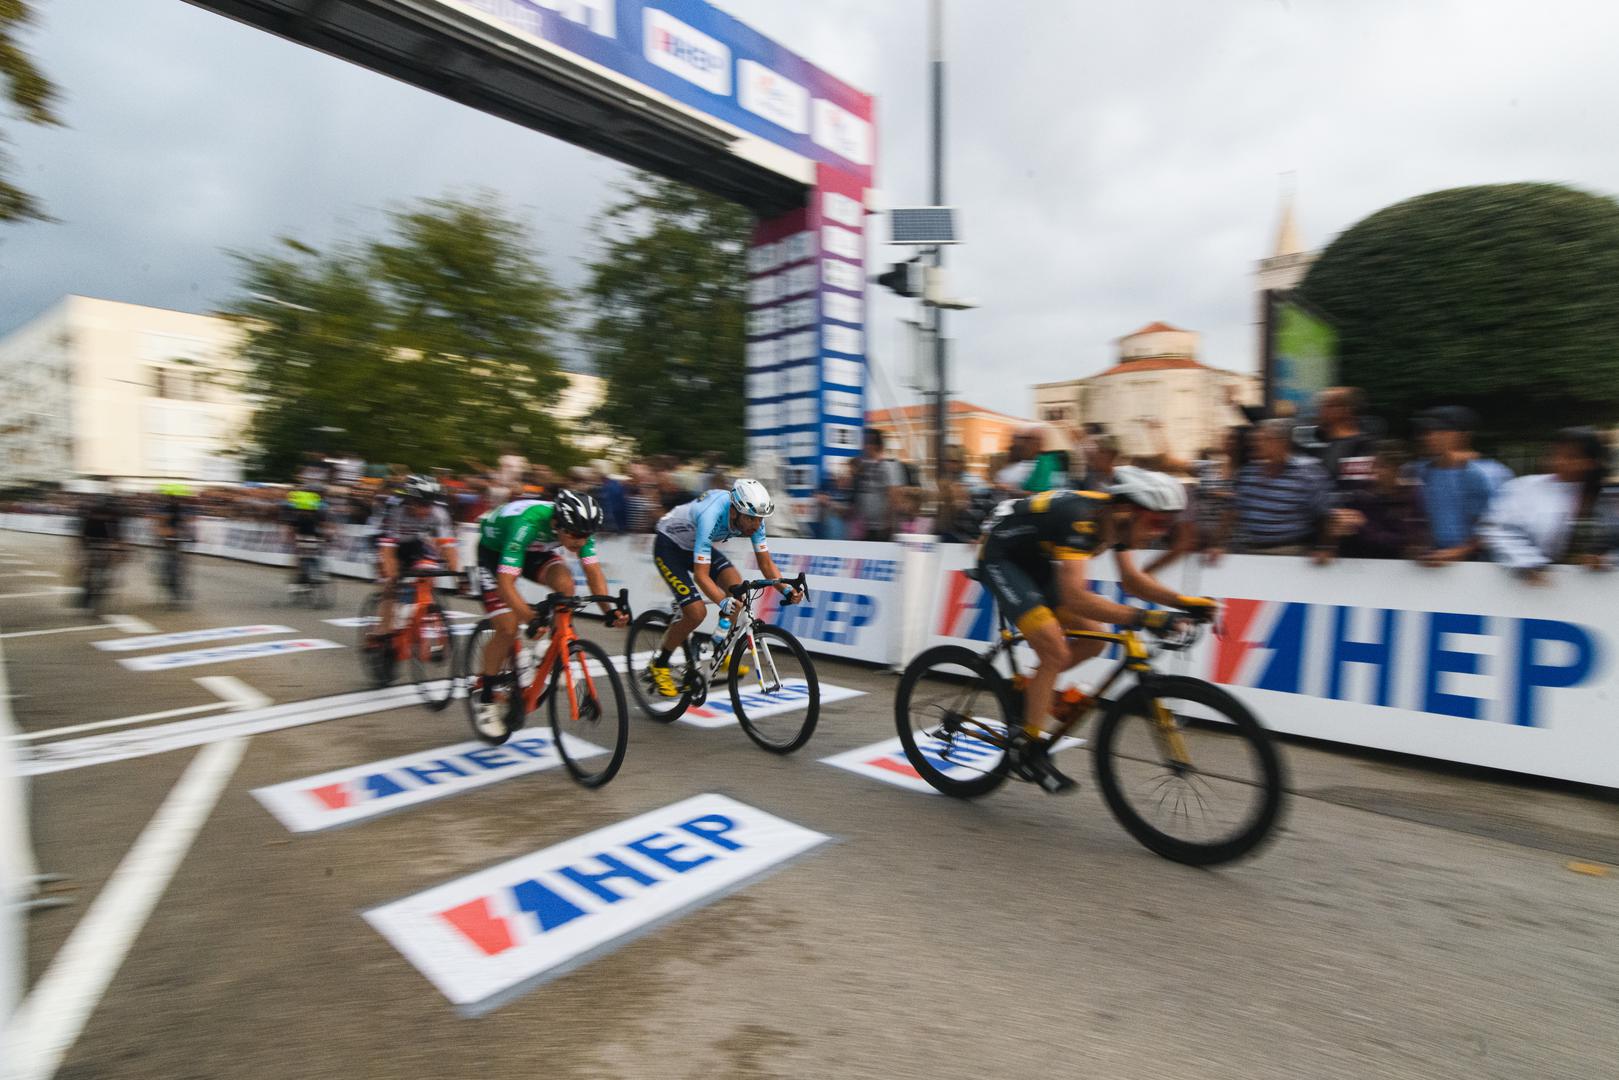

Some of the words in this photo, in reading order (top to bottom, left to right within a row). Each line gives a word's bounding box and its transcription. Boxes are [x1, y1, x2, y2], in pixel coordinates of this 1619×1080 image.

[1327, 604, 1604, 729] HEP
[400, 738, 552, 785] HEP
[558, 814, 746, 903] HEP
